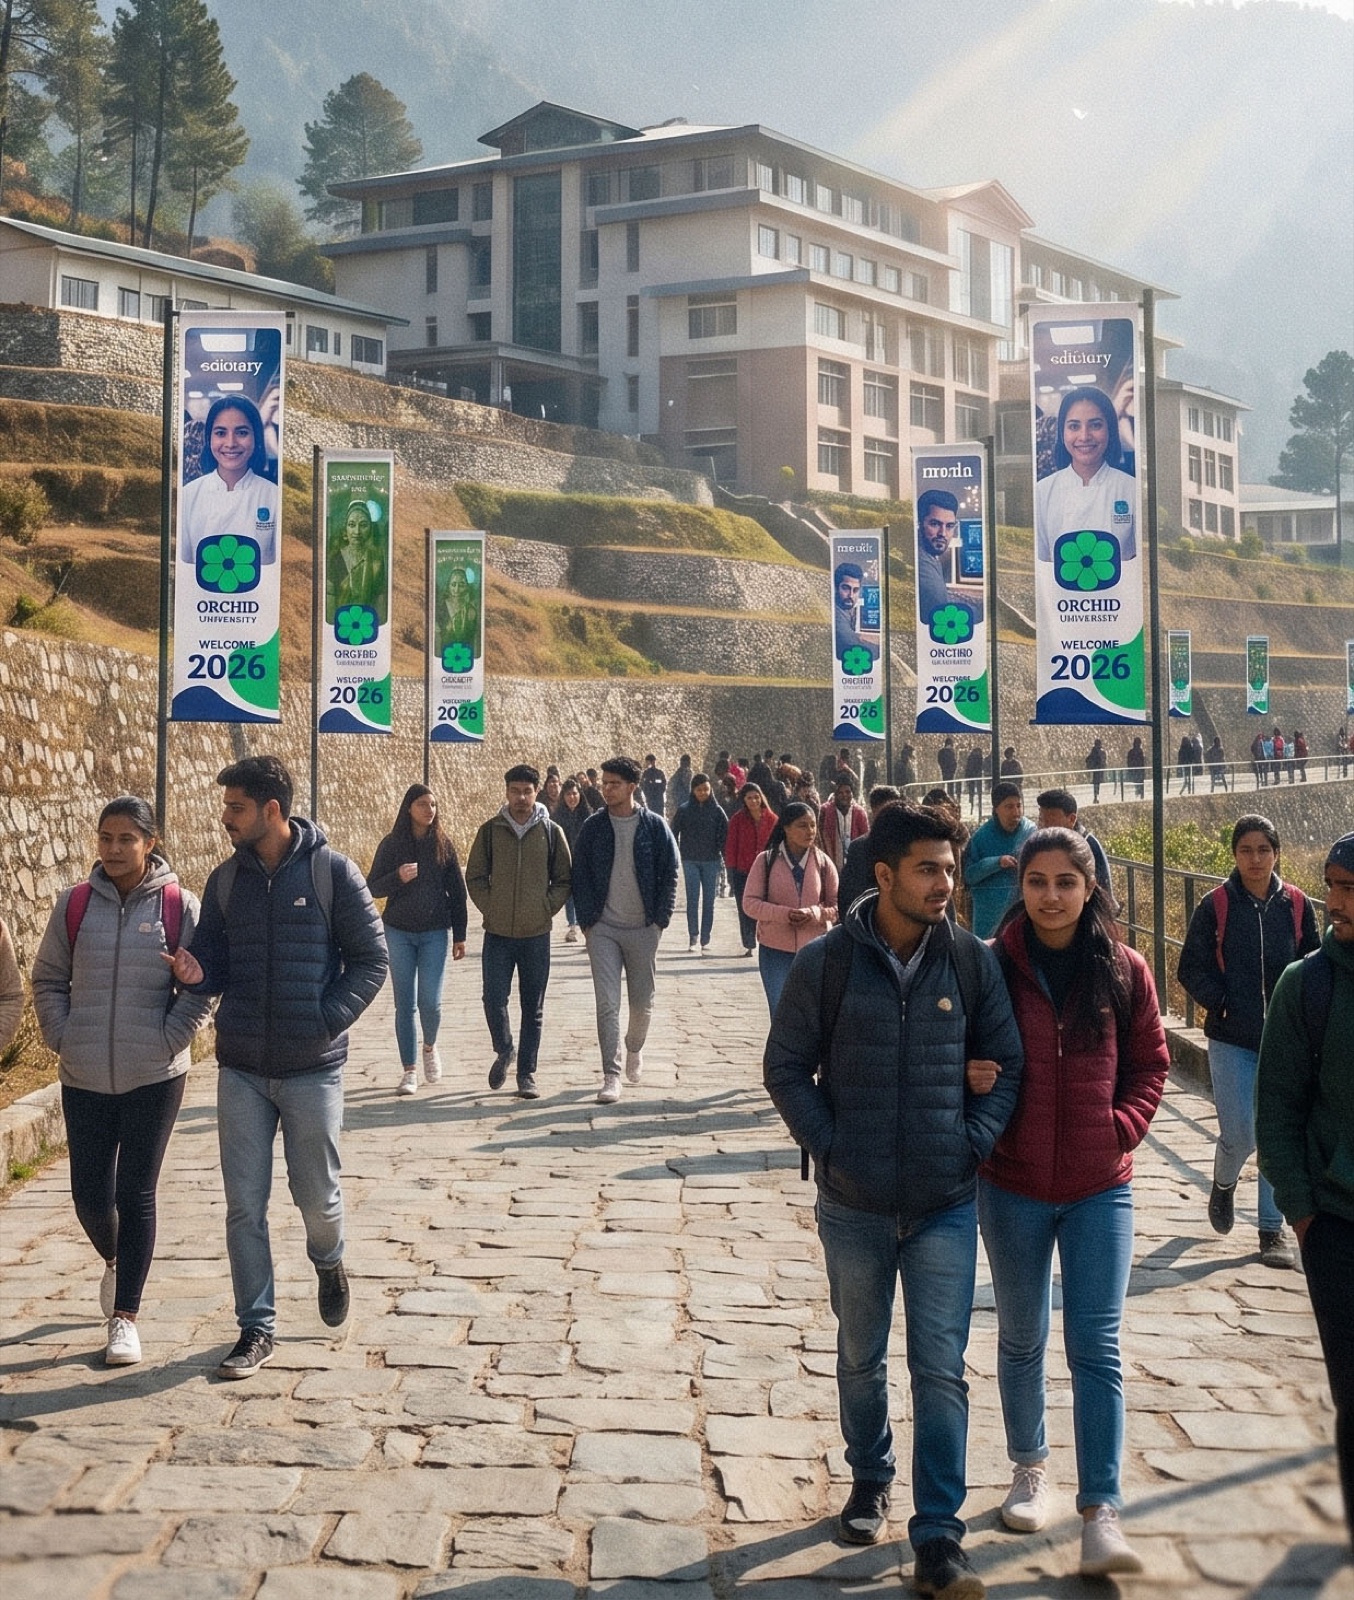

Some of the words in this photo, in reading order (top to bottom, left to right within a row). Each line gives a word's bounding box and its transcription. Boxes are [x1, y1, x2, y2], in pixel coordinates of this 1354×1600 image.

[197, 600, 259, 614] ORCHID
[1057, 598, 1121, 612] ORCHID
[199, 639, 256, 650] WELCOME
[1061, 640, 1120, 650] WELCOME
[187, 654, 266, 680] 2026
[1050, 653, 1131, 681] 2026
[329, 686, 384, 704] 2026
[925, 685, 980, 703] 2026
[437, 706, 478, 721] 2026
[840, 704, 878, 719] 2026
